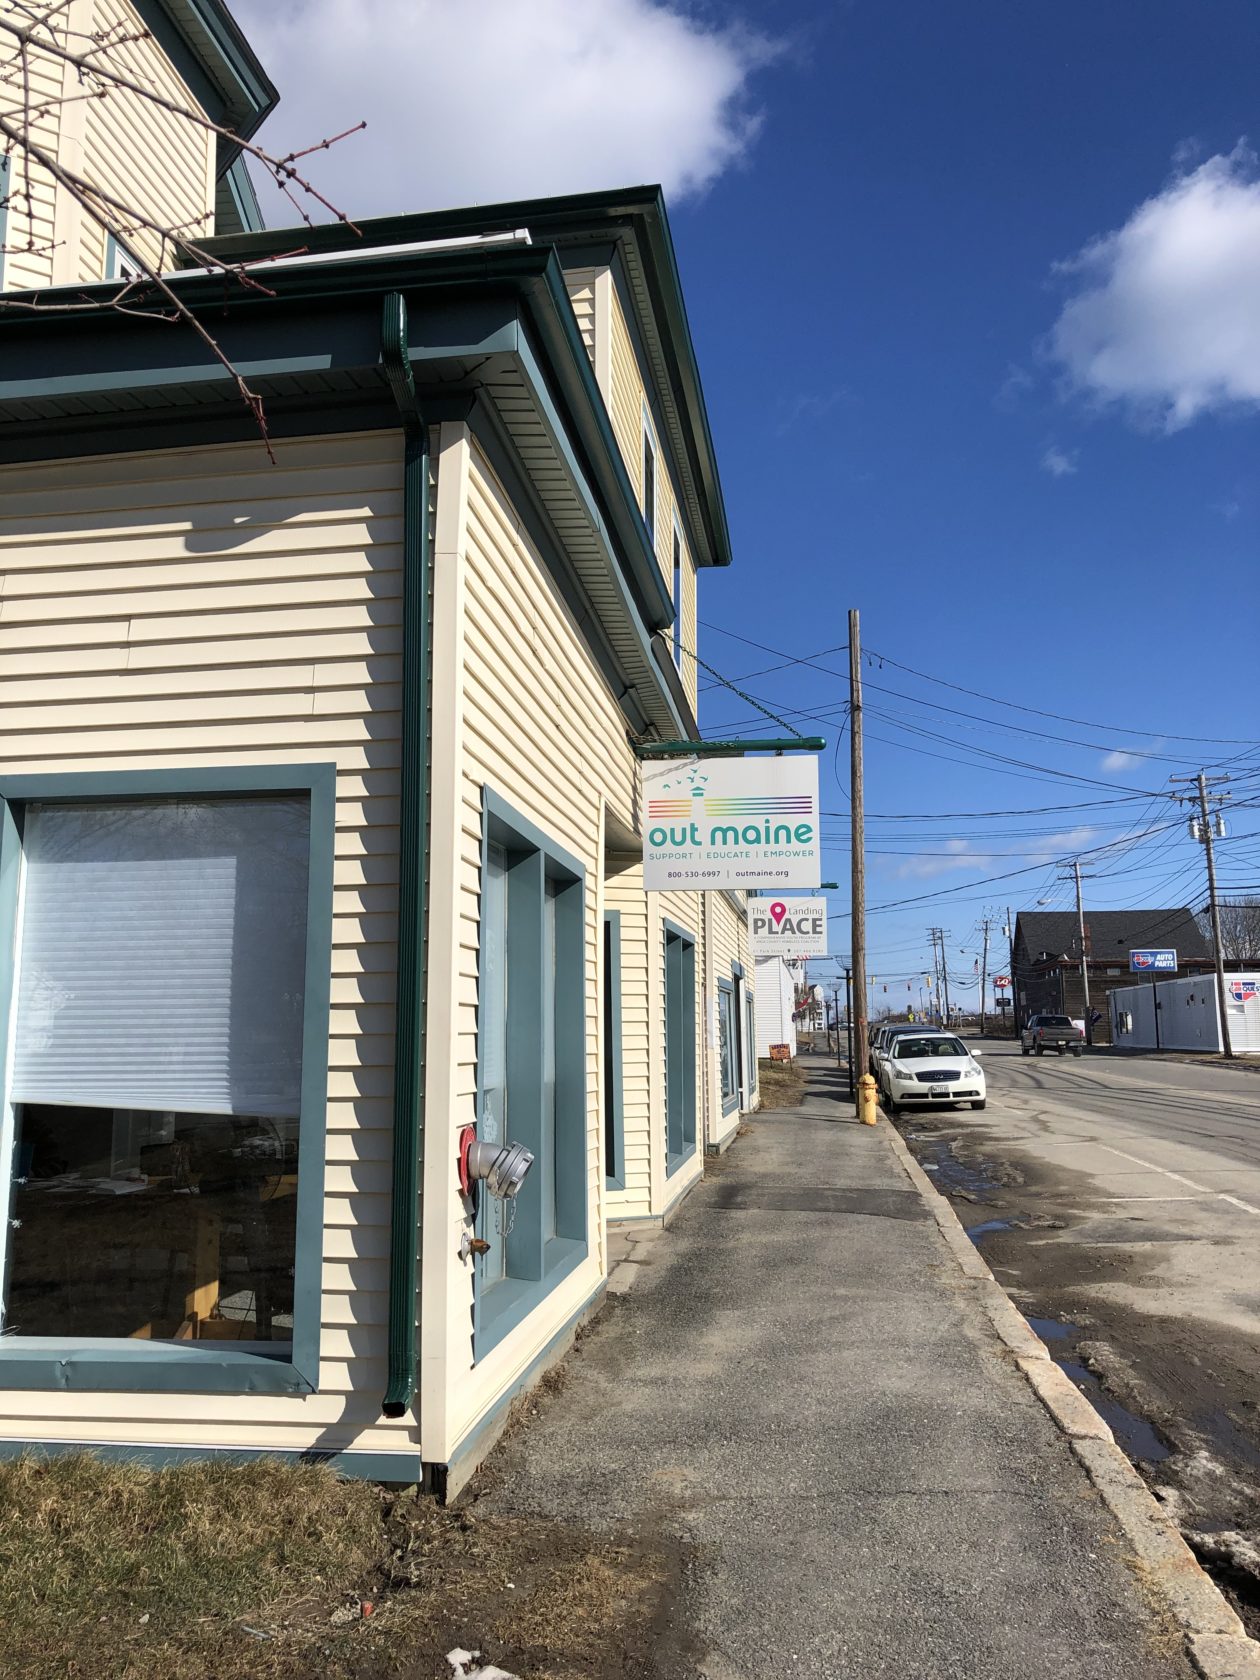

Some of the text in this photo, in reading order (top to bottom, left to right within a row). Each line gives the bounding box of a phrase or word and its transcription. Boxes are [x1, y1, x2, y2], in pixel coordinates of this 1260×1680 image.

[649, 818, 813, 847] out maine
[649, 850, 814, 861] SUPPORT EDUCATE EMPOWER
[667, 869, 789, 879] 800-530-6997 outmaine.org
[752, 907, 823, 918] The Landing
[753, 917, 823, 935] PLACE
[1154, 960, 1174, 968] PARTS
